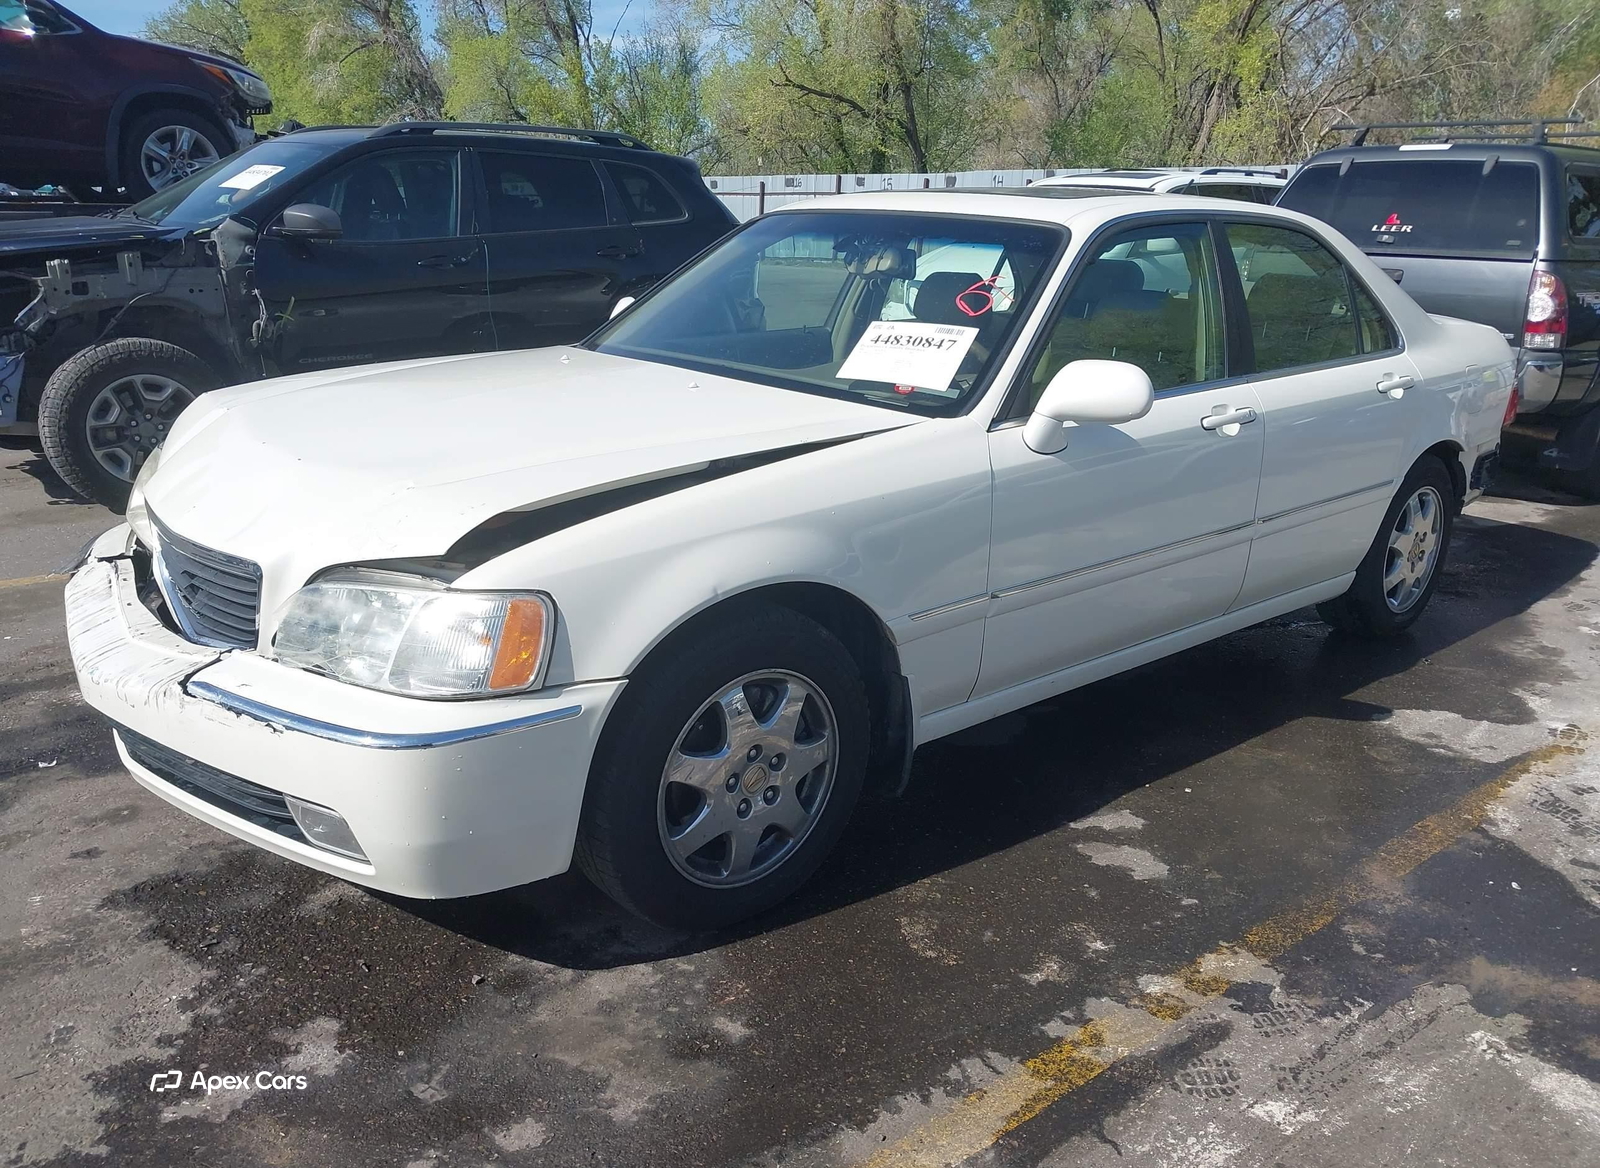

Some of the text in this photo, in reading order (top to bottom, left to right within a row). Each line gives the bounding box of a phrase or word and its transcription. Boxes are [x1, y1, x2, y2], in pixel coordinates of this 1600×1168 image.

[1371, 224, 1413, 233] LEER
[870, 333, 957, 351] 44830847
[299, 353, 373, 364] CHEROKEE
